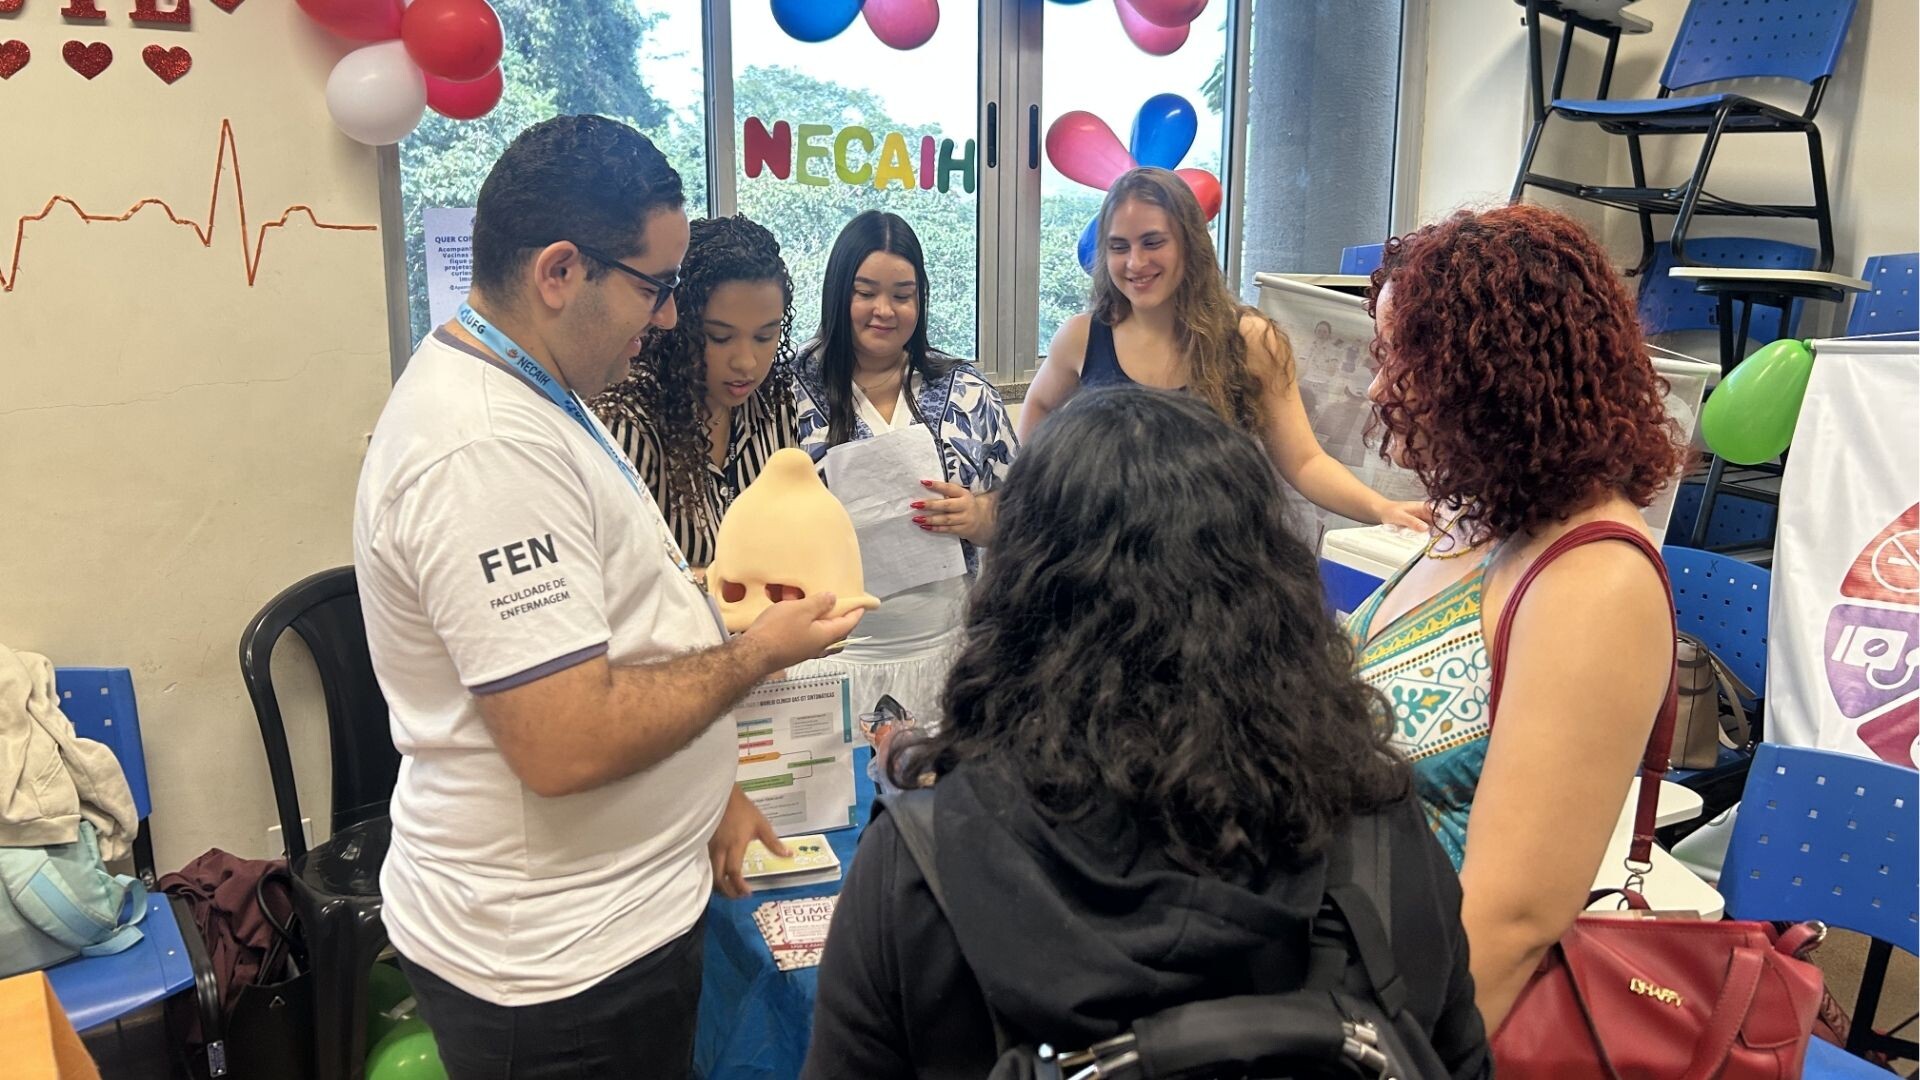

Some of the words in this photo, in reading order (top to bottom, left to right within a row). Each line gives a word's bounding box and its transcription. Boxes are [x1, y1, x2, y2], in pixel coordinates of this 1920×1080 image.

[744, 116, 975, 194] NECAIH
[435, 236, 456, 244] QUER
[466, 316, 486, 334] UFG
[517, 356, 551, 386] NECAIH
[478, 533, 558, 584] FEN
[490, 581, 552, 609] FACULDADE
[553, 577, 567, 589] DE
[500, 590, 571, 620] ENFERMAGEM
[784, 908, 804, 916] EU
[810, 906, 832, 915] ME
